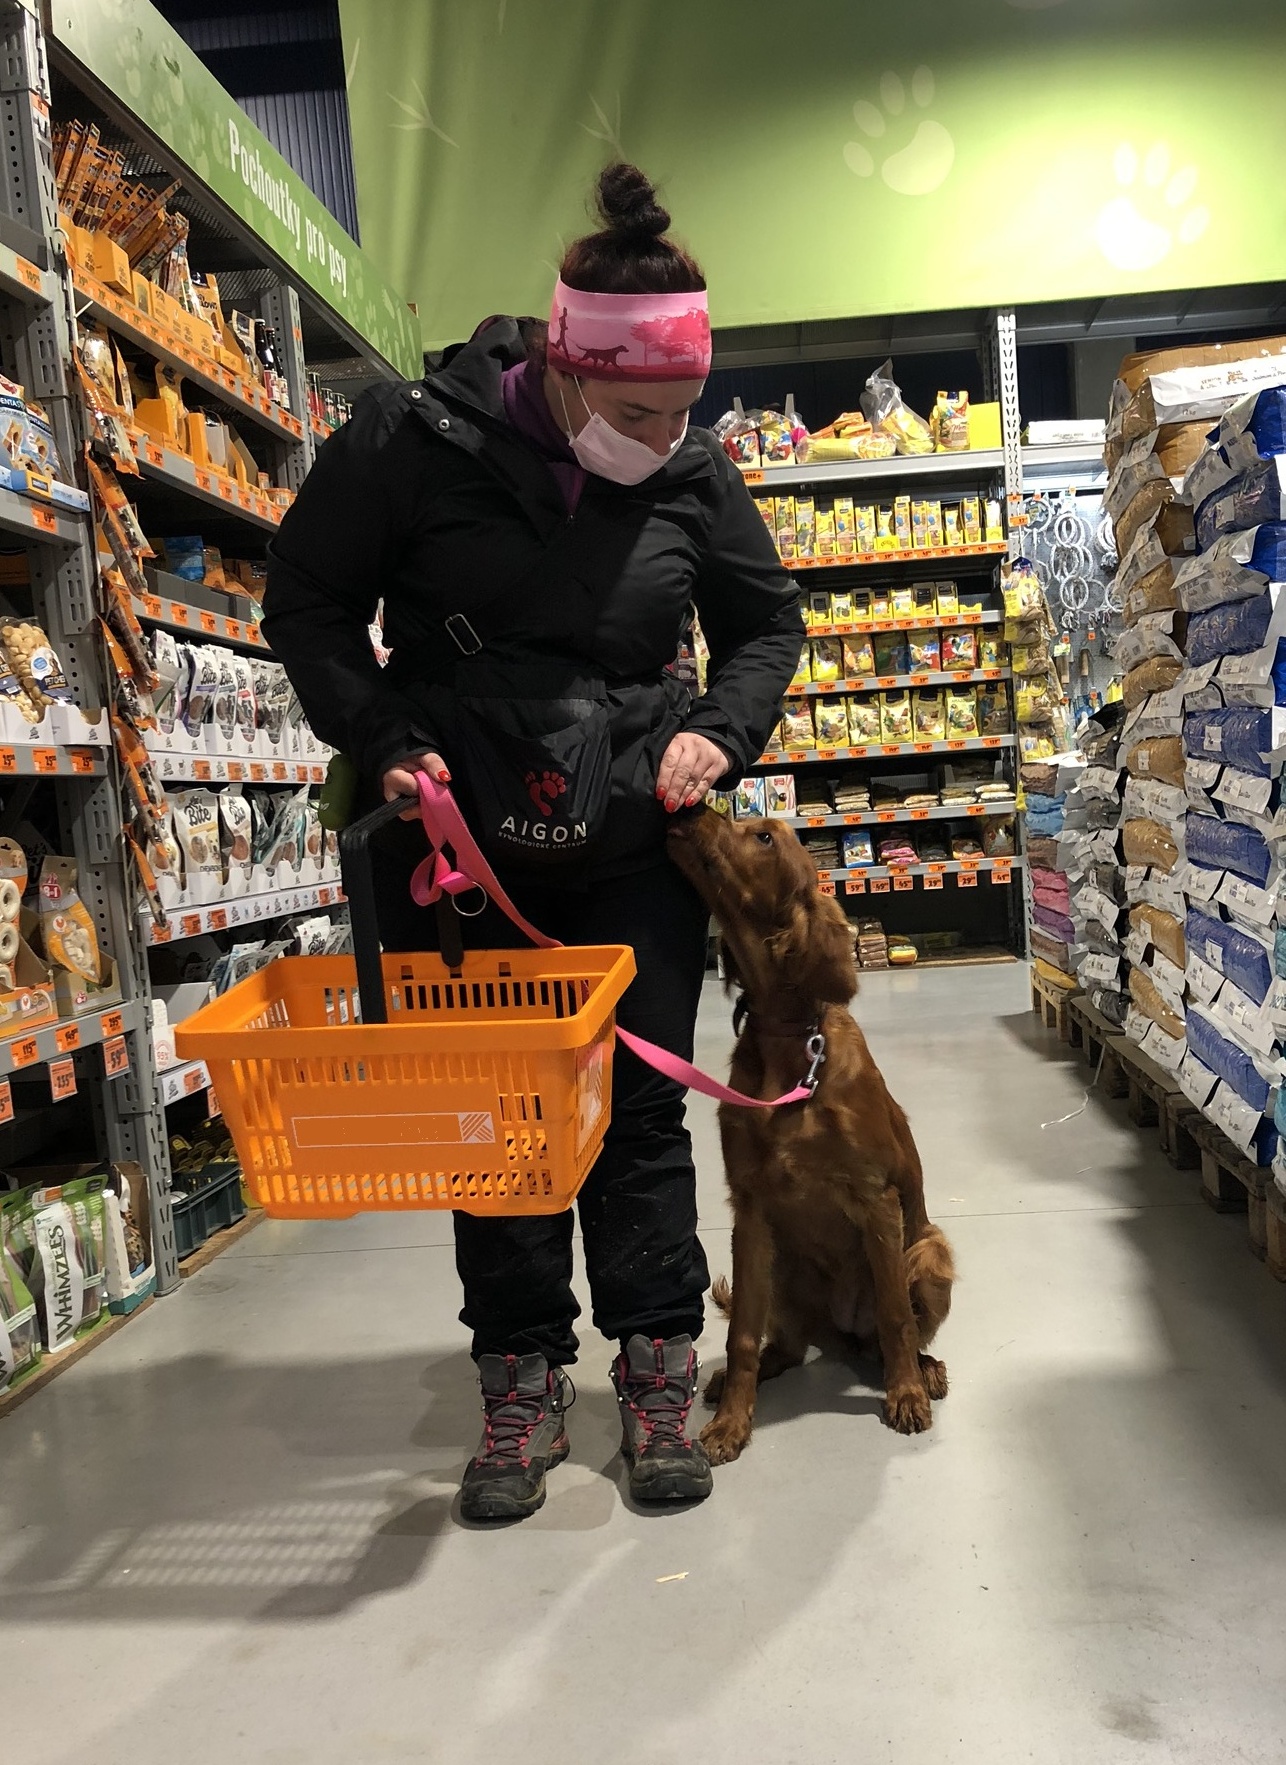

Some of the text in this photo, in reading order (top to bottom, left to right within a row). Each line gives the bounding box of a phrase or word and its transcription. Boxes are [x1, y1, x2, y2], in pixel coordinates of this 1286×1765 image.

[229, 118, 347, 298] Pochoutky pro psy
[184, 803, 211, 827] Bite
[500, 815, 587, 843] AIGON
[48, 1224, 73, 1344] WHIMZEES
